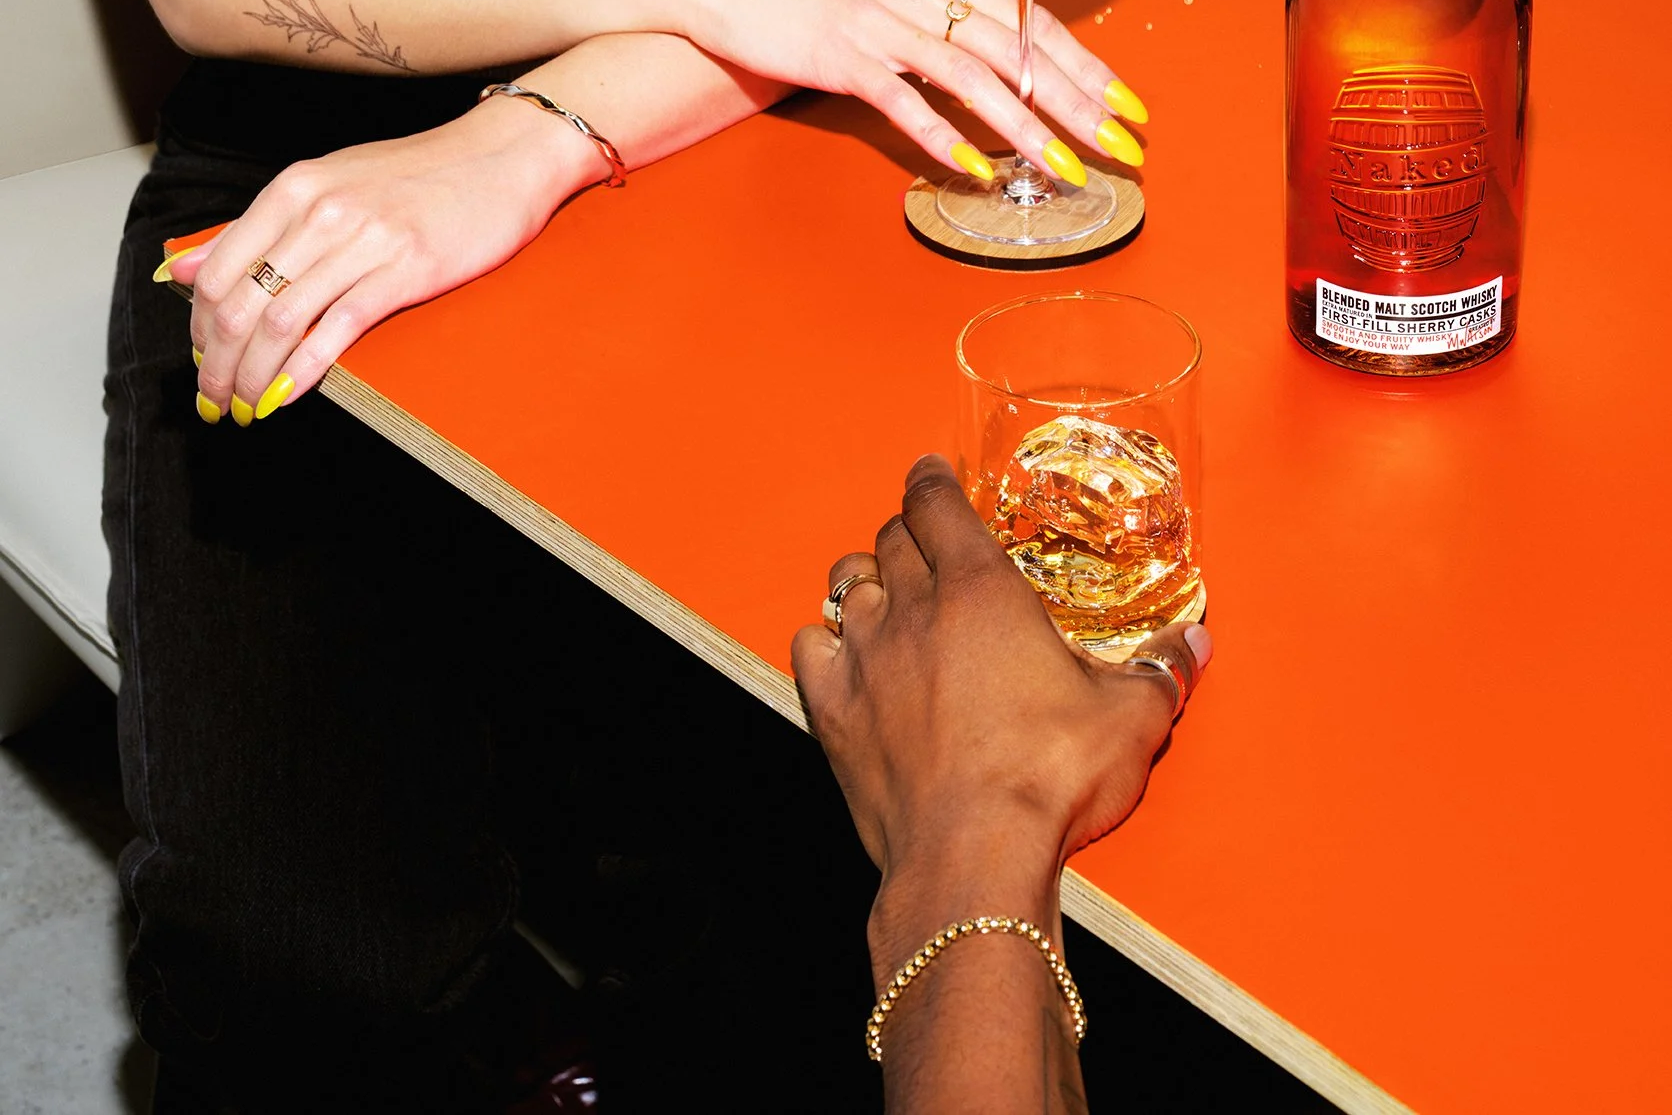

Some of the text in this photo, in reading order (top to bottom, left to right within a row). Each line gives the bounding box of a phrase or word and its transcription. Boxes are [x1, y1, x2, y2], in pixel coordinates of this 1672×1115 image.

[1329, 140, 1489, 182] Naked
[1322, 284, 1498, 316] BLENDED MALT SCOTCH WHISKY
[1322, 299, 1338, 311] EXTRA
[1338, 305, 1365, 318] MATURED
[1322, 304, 1497, 334] FIRST-FILL SHERRY CASKS
[1322, 319, 1453, 344] SMOOTH AND FRUITY WHISKY
[1322, 326, 1411, 351] TO ENJOY YOUR WAY
